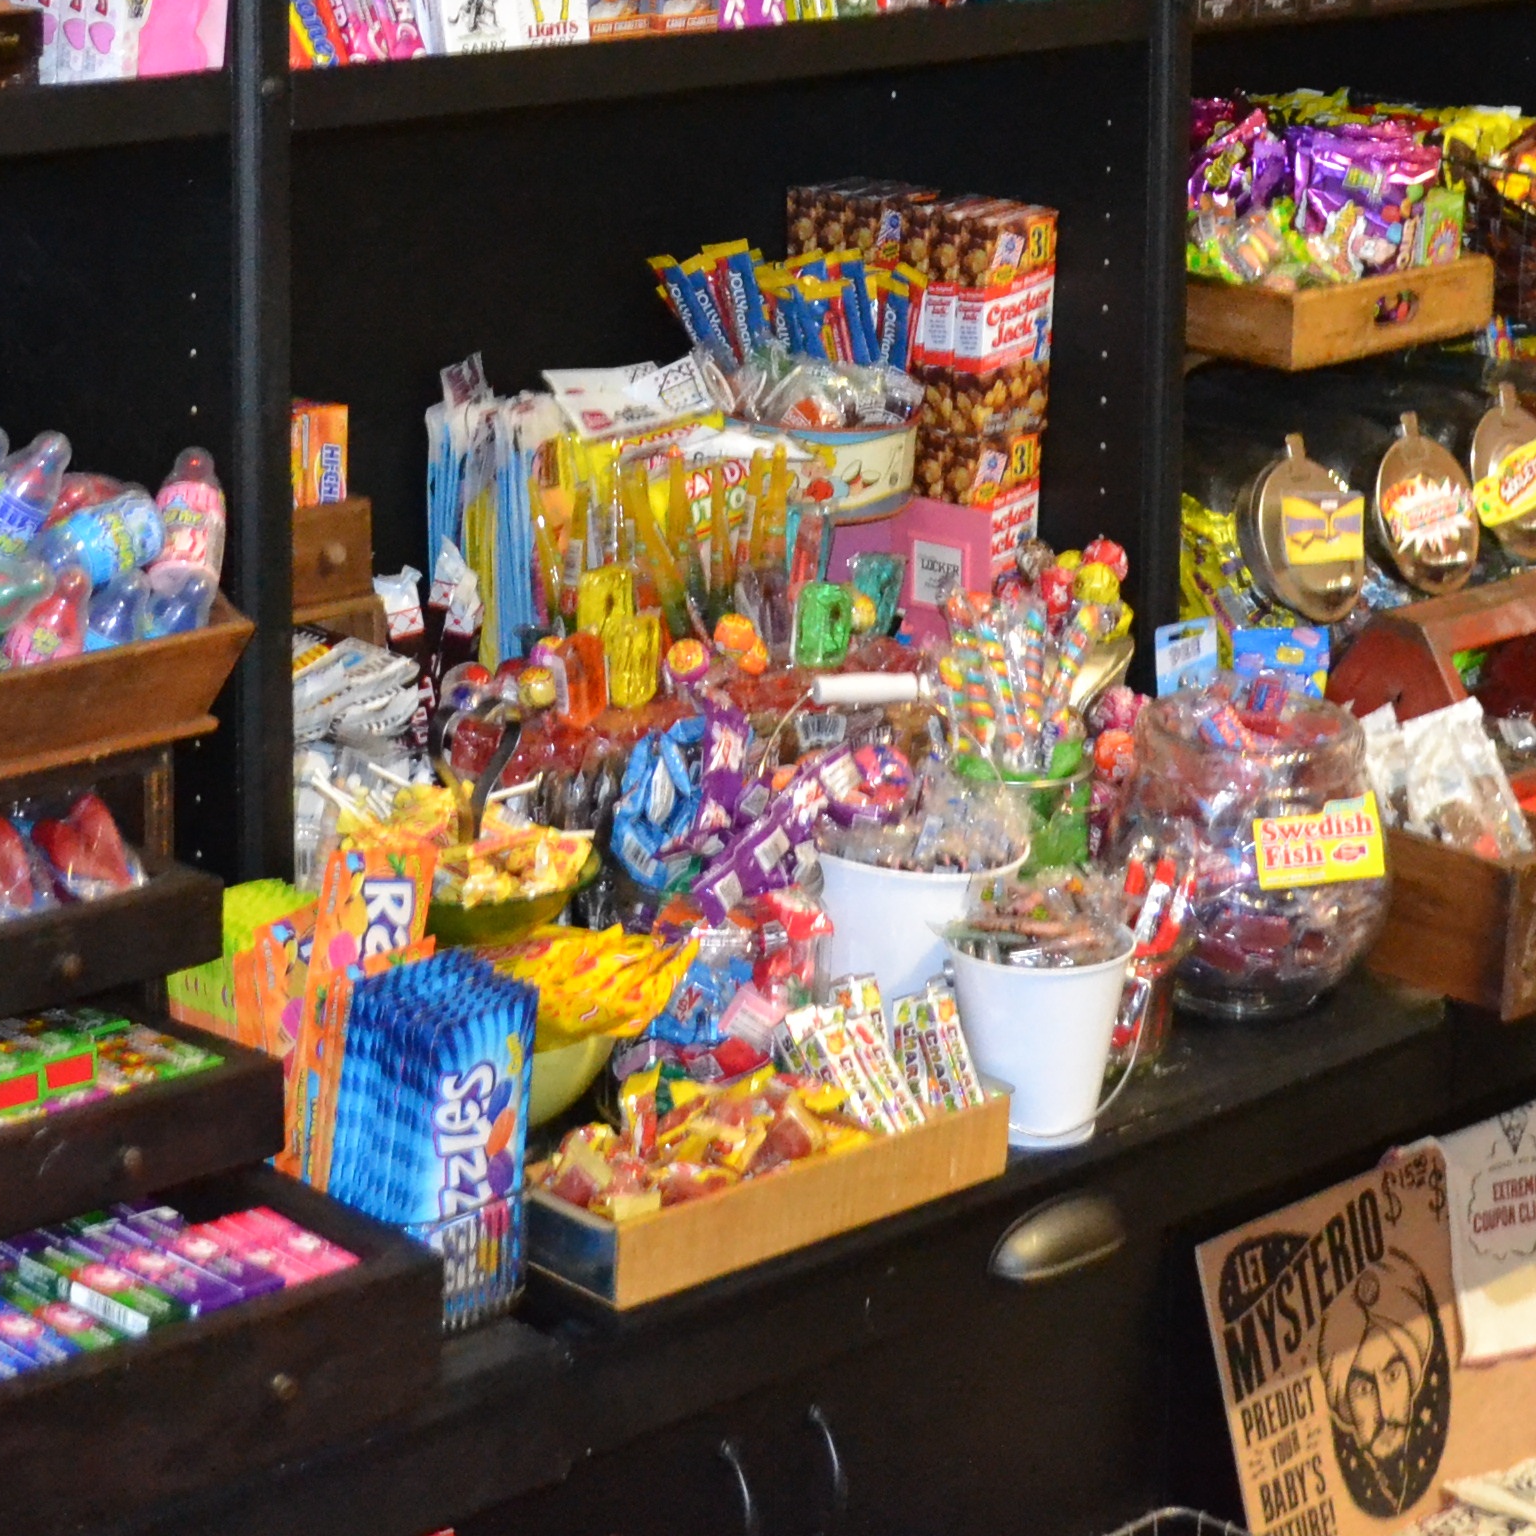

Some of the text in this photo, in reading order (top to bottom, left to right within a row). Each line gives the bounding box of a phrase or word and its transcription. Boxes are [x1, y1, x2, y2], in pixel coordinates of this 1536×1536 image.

[527, 22, 579, 39] LIGHTS
[986, 287, 1052, 327] Cracker
[991, 315, 1034, 349] Jack
[1260, 811, 1375, 844] Swedish
[1262, 840, 1326, 871] Fish
[1472, 1205, 1516, 1235] COUPON
[1222, 1186, 1386, 1406] MYSTERIO
[1238, 1374, 1316, 1448] PREDICT
[1258, 1454, 1327, 1524] BABY'S
